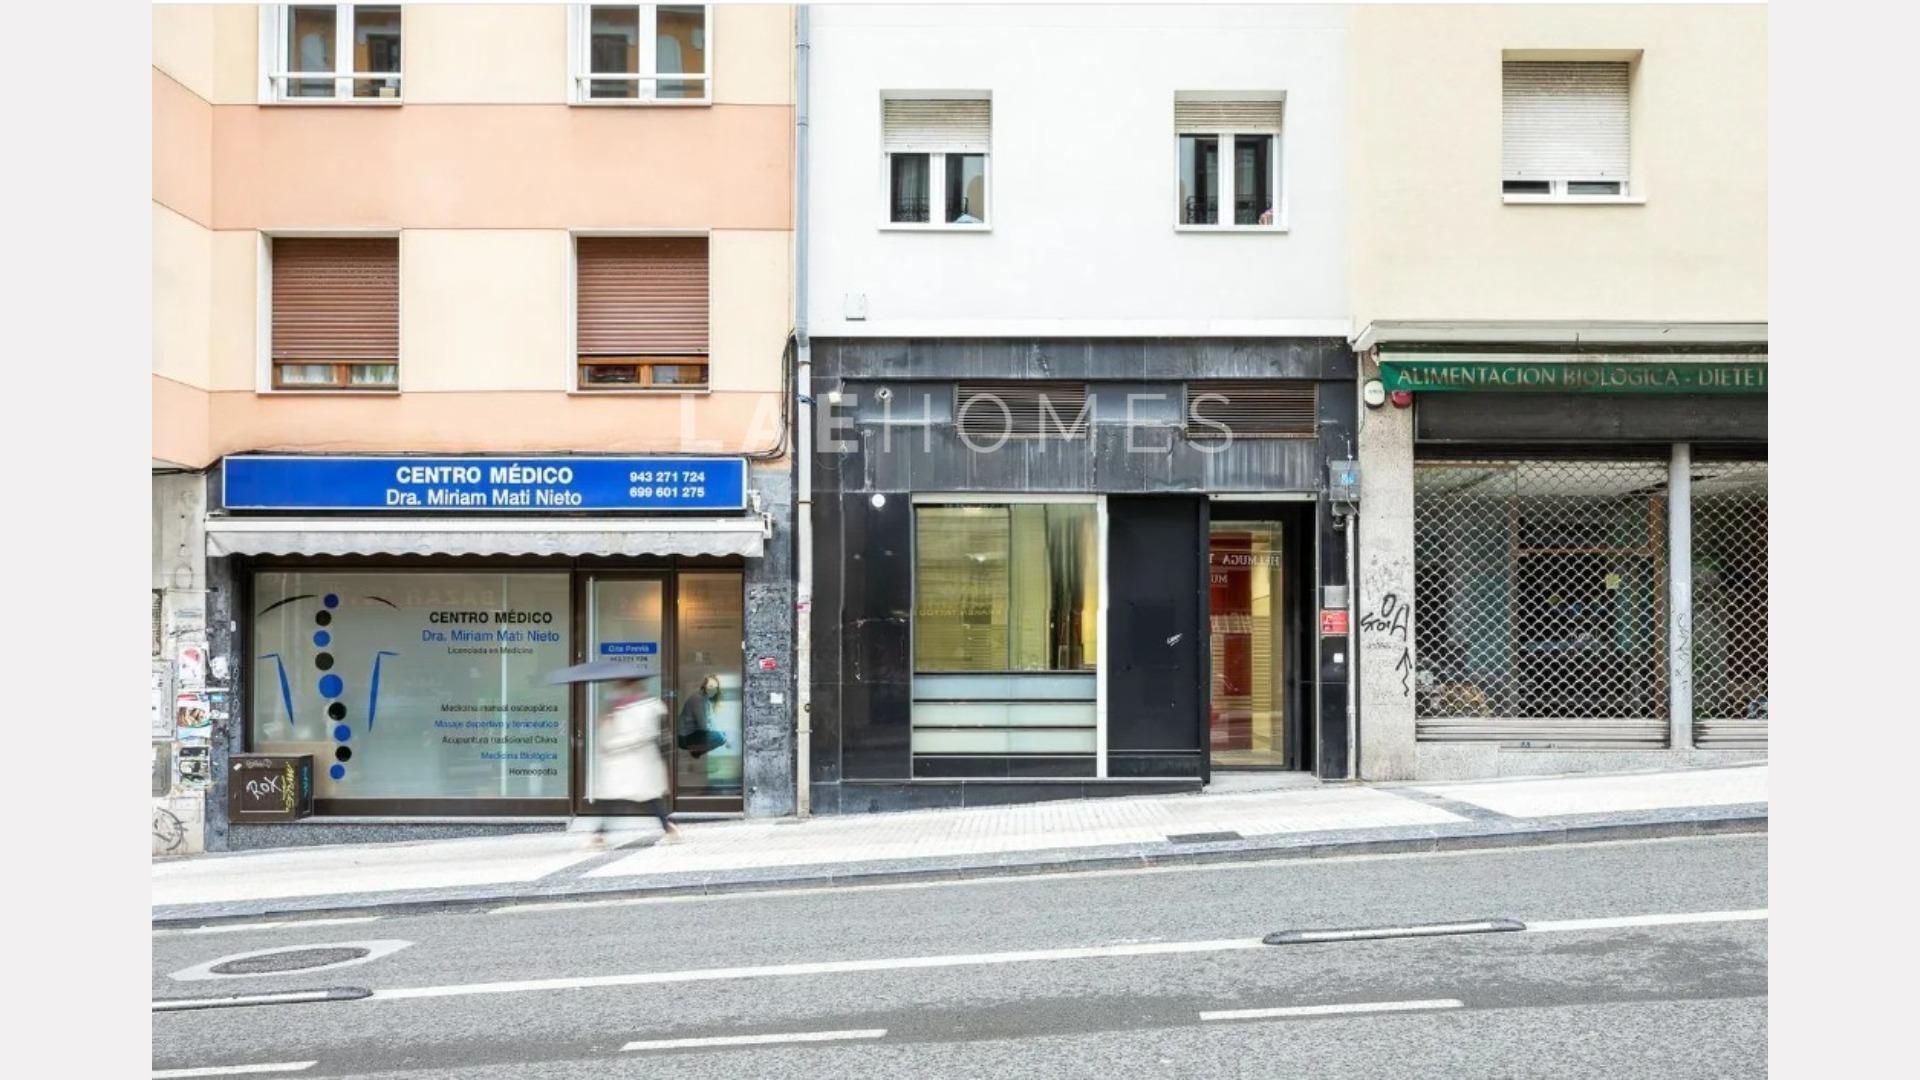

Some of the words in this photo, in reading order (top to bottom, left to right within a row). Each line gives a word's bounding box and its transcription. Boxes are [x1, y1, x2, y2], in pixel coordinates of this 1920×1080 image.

[1398, 366, 1555, 386] ALIMENTACION
[1699, 366, 1764, 386] DIETET
[396, 467, 481, 484] CENTRO
[489, 463, 573, 484] MÉDICO
[629, 471, 654, 483] 943
[656, 471, 680, 483] 271
[682, 471, 705, 483] 724
[386, 490, 421, 506] Dra.
[427, 490, 487, 506] Miriam
[492, 490, 531, 506] Mati
[537, 490, 582, 506] Nieto
[629, 486, 654, 498] 699
[656, 486, 680, 498] 601
[682, 486, 705, 498] 275
[429, 611, 489, 624] CENTRO
[494, 609, 553, 624] MÉDICO
[421, 629, 447, 642] Dra.
[451, 629, 494, 642] Miriam
[496, 629, 524, 642] Mati
[527, 629, 560, 642] Nieto
